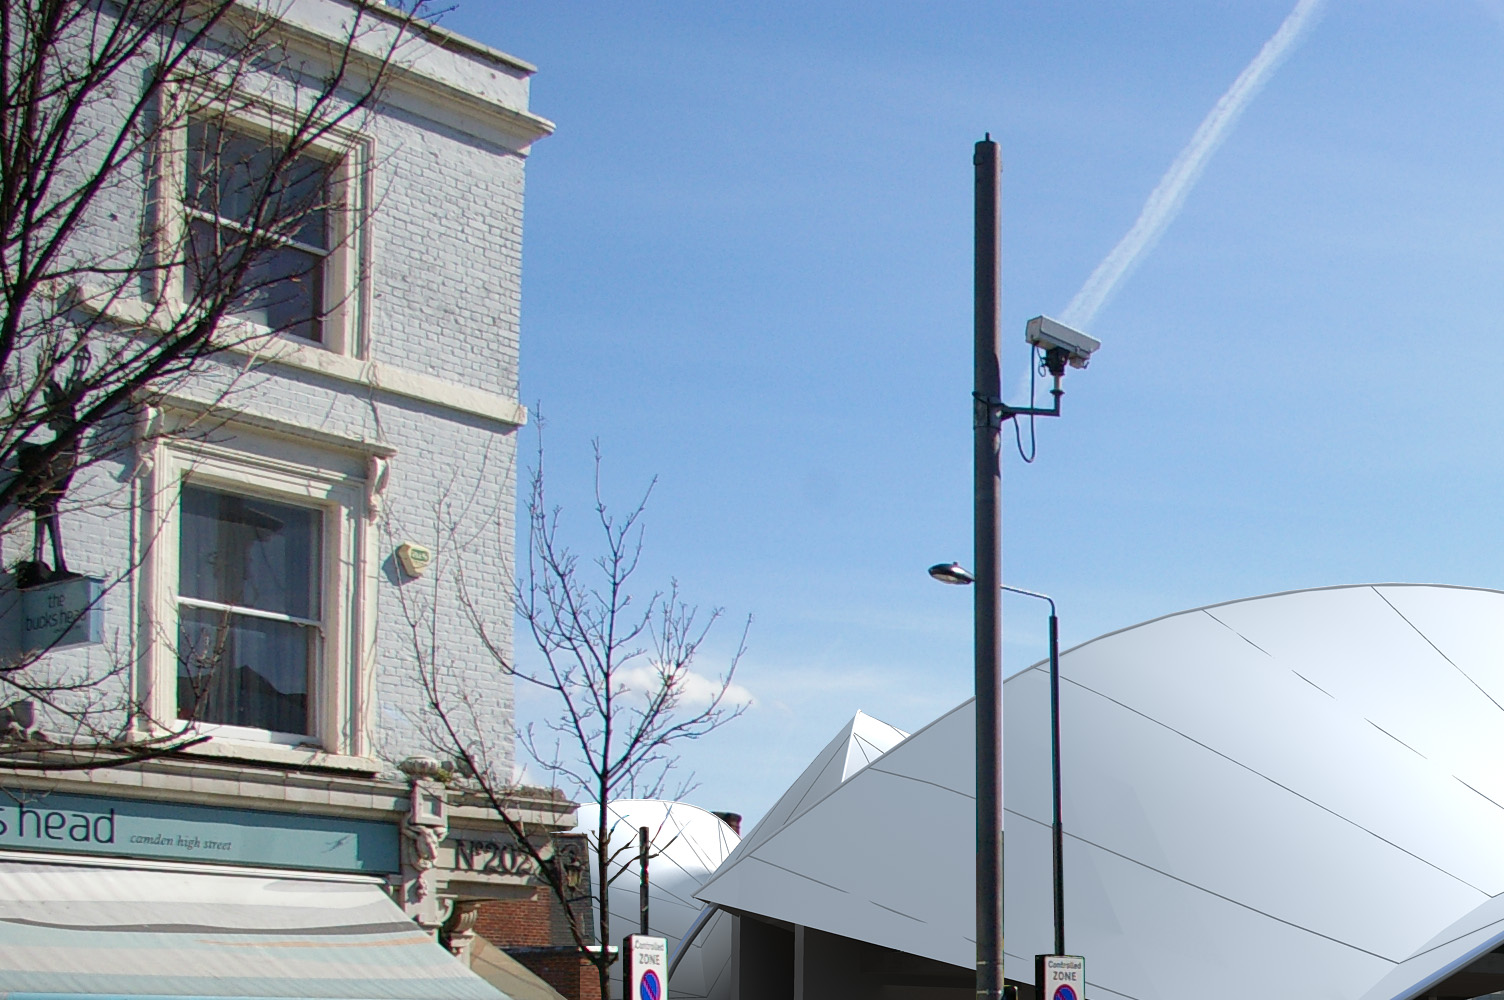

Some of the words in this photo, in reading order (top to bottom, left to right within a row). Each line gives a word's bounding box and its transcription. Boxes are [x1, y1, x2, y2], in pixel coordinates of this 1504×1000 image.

[18, 802, 115, 844] head
[130, 833, 174, 847] camden
[176, 835, 201, 851] high
[203, 840, 232, 851] street
[634, 939, 665, 951] Controlled
[639, 954, 661, 965] ZONE
[1048, 961, 1082, 970] Controlled
[1053, 971, 1077, 981] ZONE
